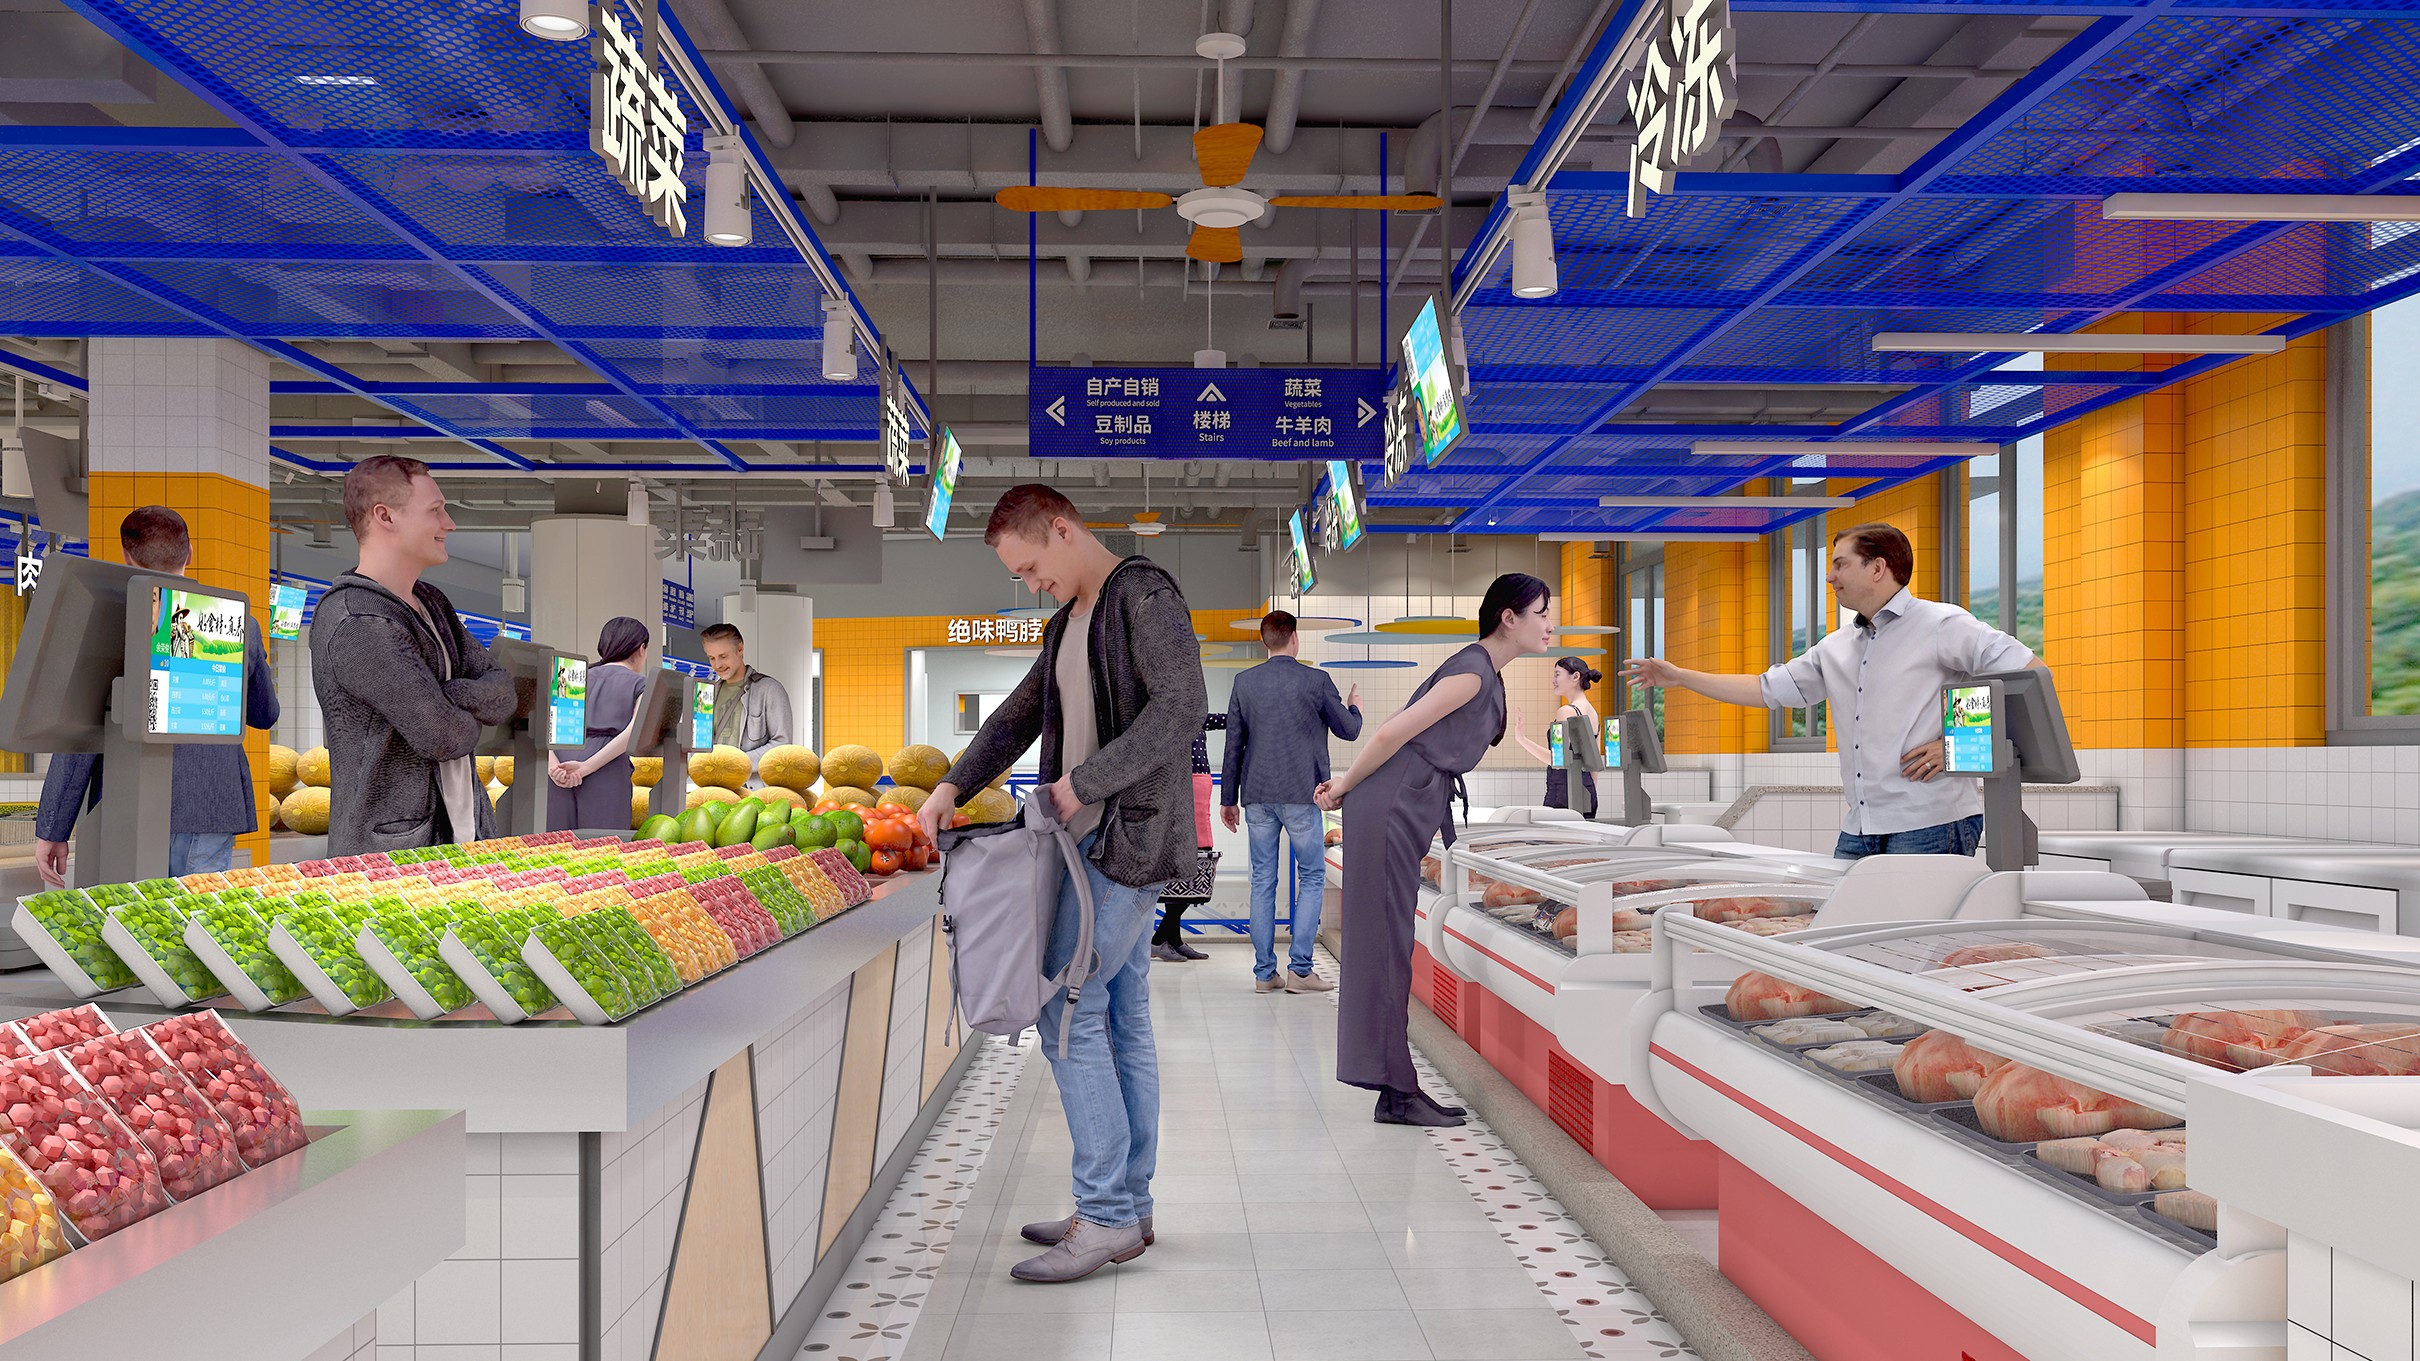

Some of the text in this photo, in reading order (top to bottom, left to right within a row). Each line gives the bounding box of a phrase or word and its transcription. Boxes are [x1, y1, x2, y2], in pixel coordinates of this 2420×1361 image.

[1627, 0, 1725, 219] 冷冻
[602, 7, 687, 238] 蔬菜
[1087, 377, 1159, 396] 自产自销
[1285, 378, 1322, 397] 蔬菜
[1100, 400, 1131, 408] produced
[1284, 401, 1322, 409] Vegetables
[1095, 415, 1151, 434] 豆制品
[1193, 410, 1230, 429] 楼梯
[1275, 416, 1332, 435] 牛羊肉
[886, 394, 910, 487] 蔬菜
[1100, 437, 1146, 446] Soy products
[1199, 433, 1225, 442] Stairs
[1272, 438, 1335, 447] Beef and lamb
[17, 551, 43, 597] 肉
[947, 618, 1043, 643] 绝味鸭脖
